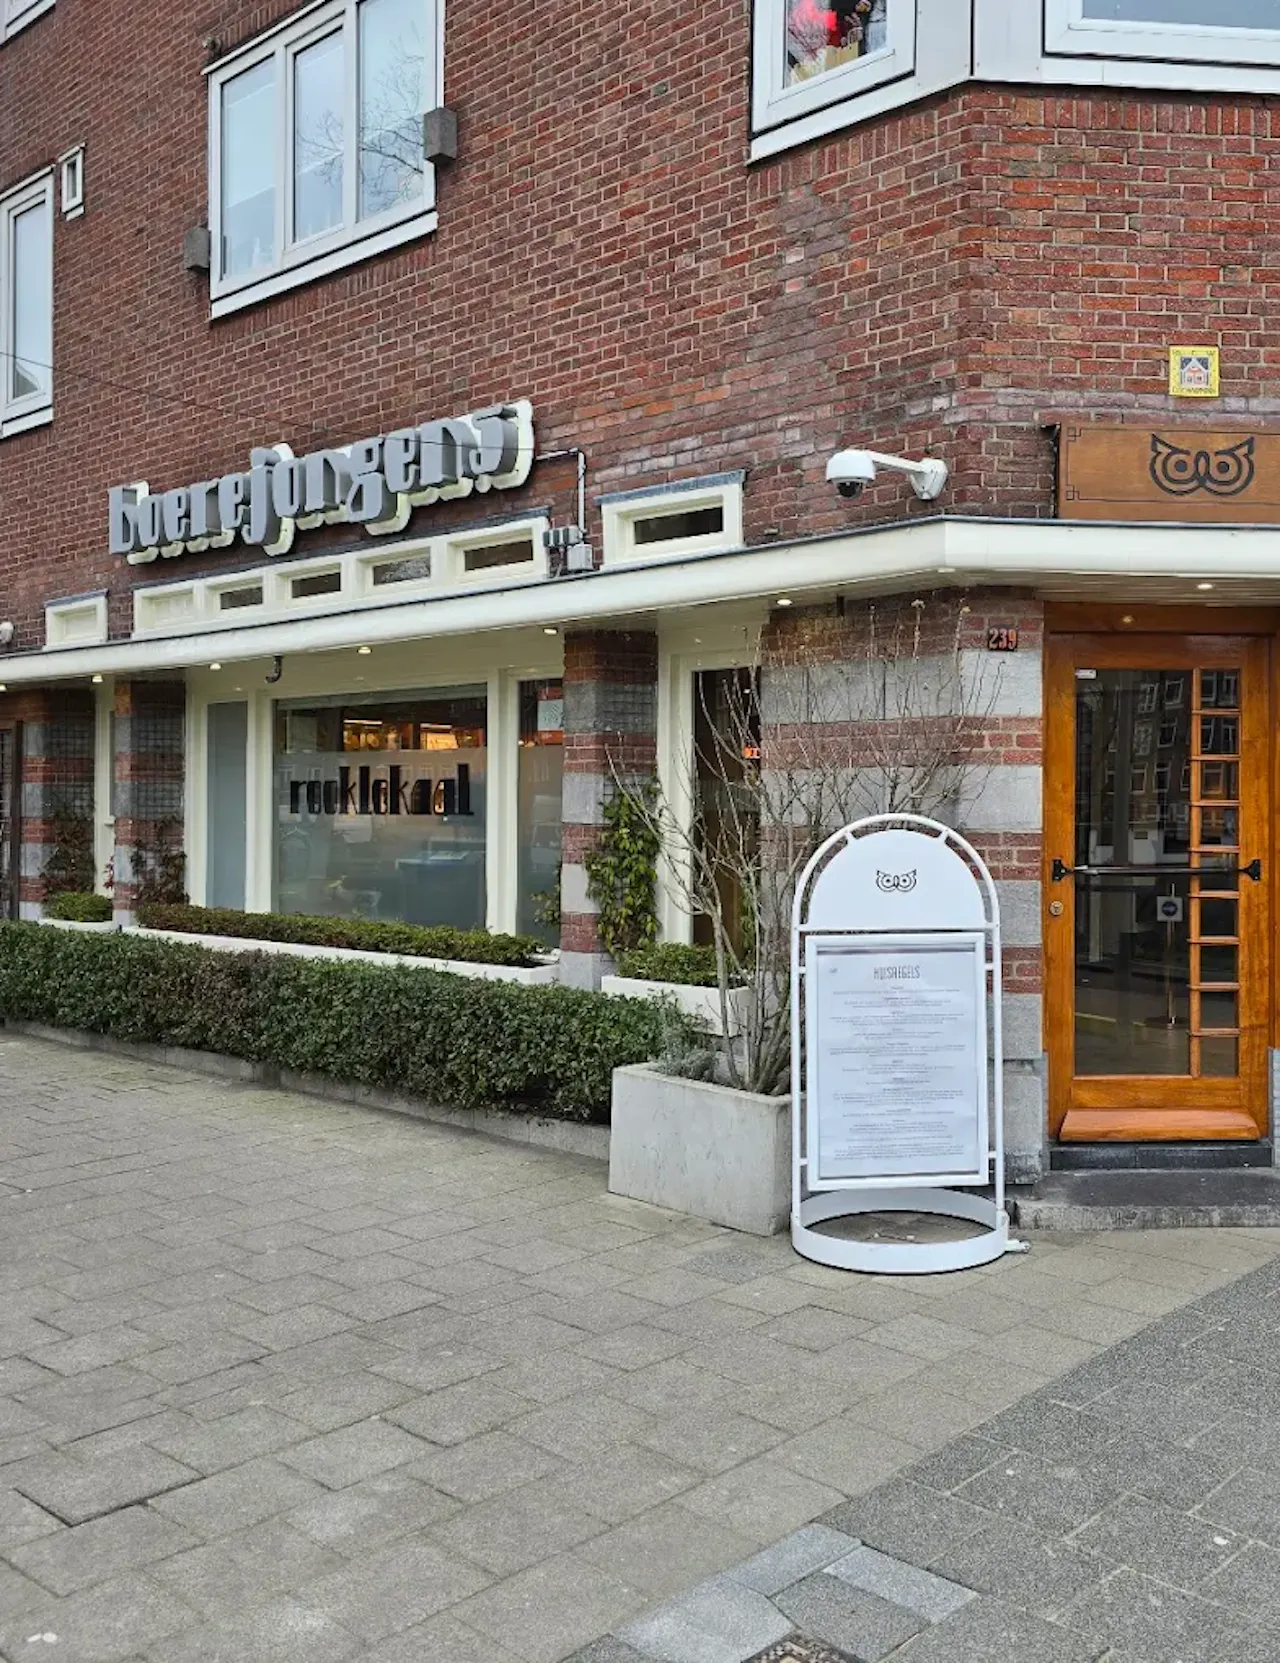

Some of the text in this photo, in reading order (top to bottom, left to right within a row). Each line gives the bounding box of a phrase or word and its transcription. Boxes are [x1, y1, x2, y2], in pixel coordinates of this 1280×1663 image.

[108, 404, 522, 554] boerejongens
[989, 627, 1017, 650] 239
[289, 763, 474, 816] rooklokaal
